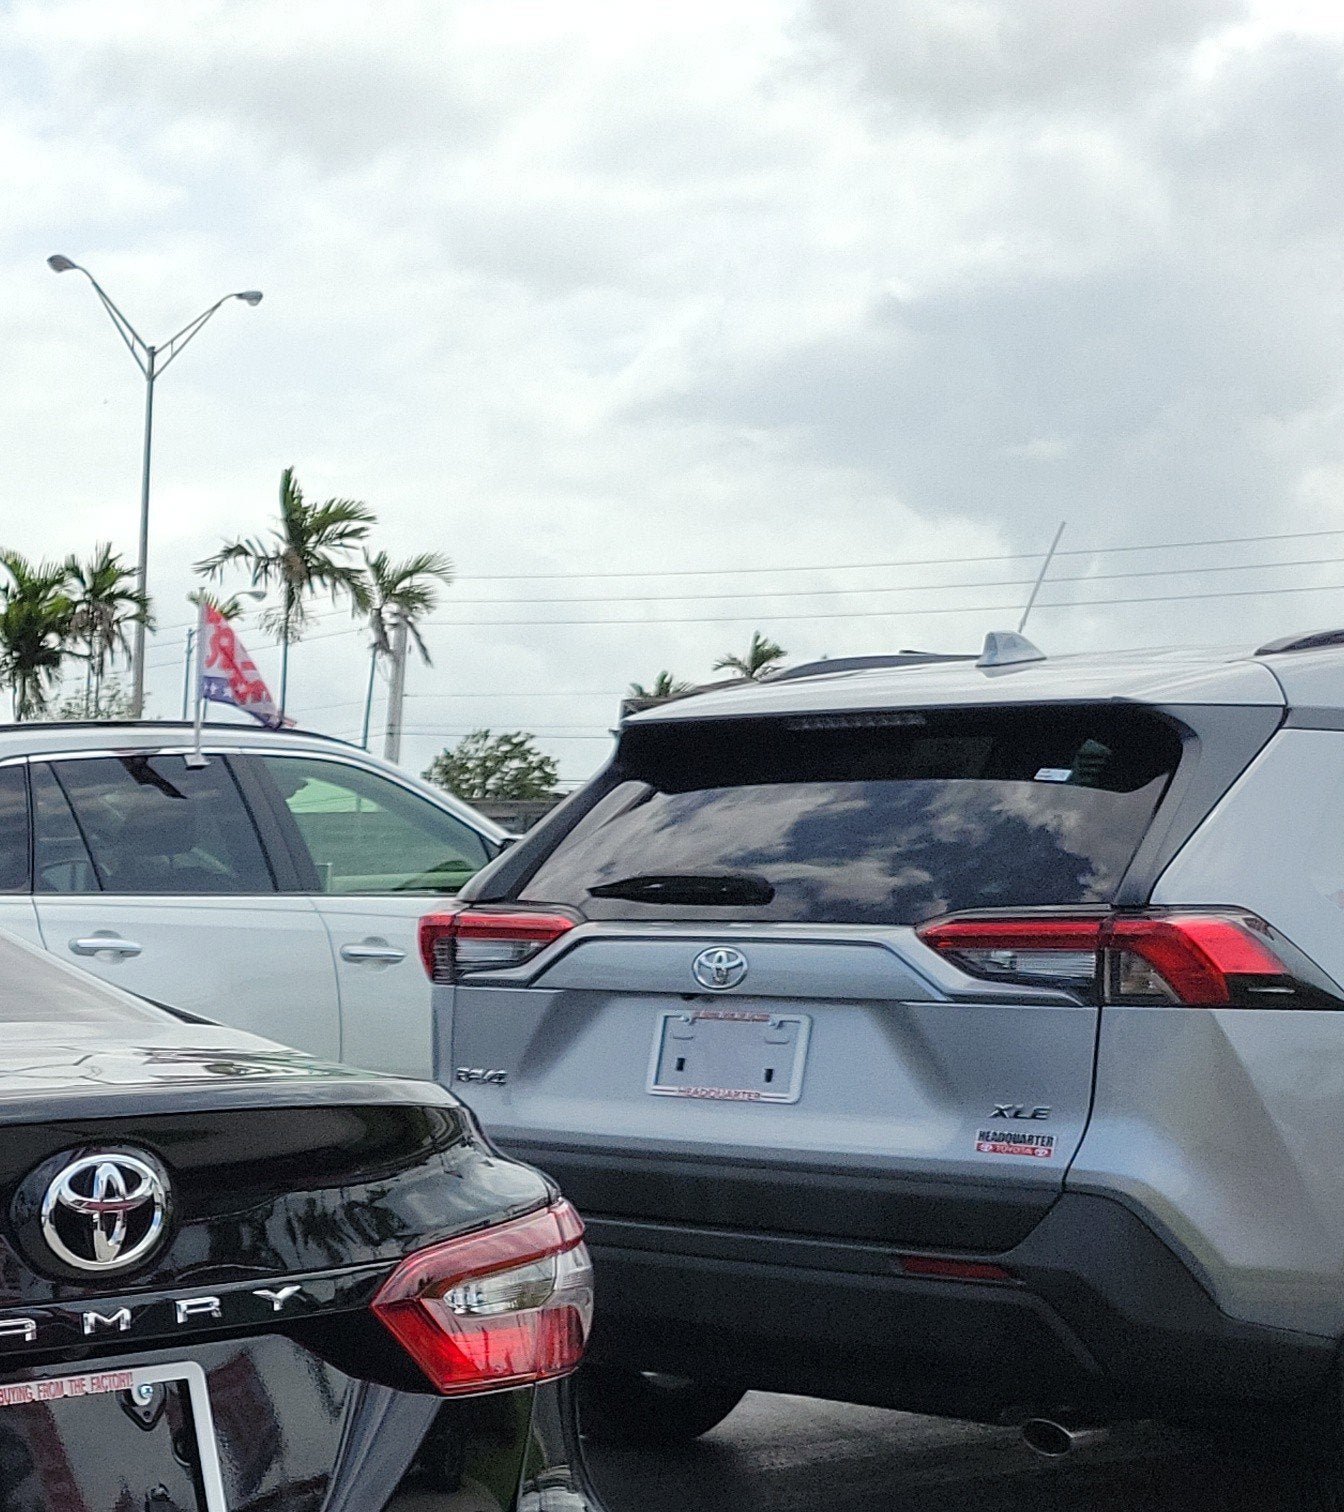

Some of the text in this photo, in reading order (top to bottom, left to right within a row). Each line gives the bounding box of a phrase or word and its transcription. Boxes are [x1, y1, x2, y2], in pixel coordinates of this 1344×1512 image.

[988, 1103, 1052, 1120] XLE
[978, 1130, 1054, 1147] HEADQUARTER
[37, 1380, 64, 1400] FROM
[68, 1377, 86, 1395] THE
[90, 1372, 134, 1393] FACTORY!
